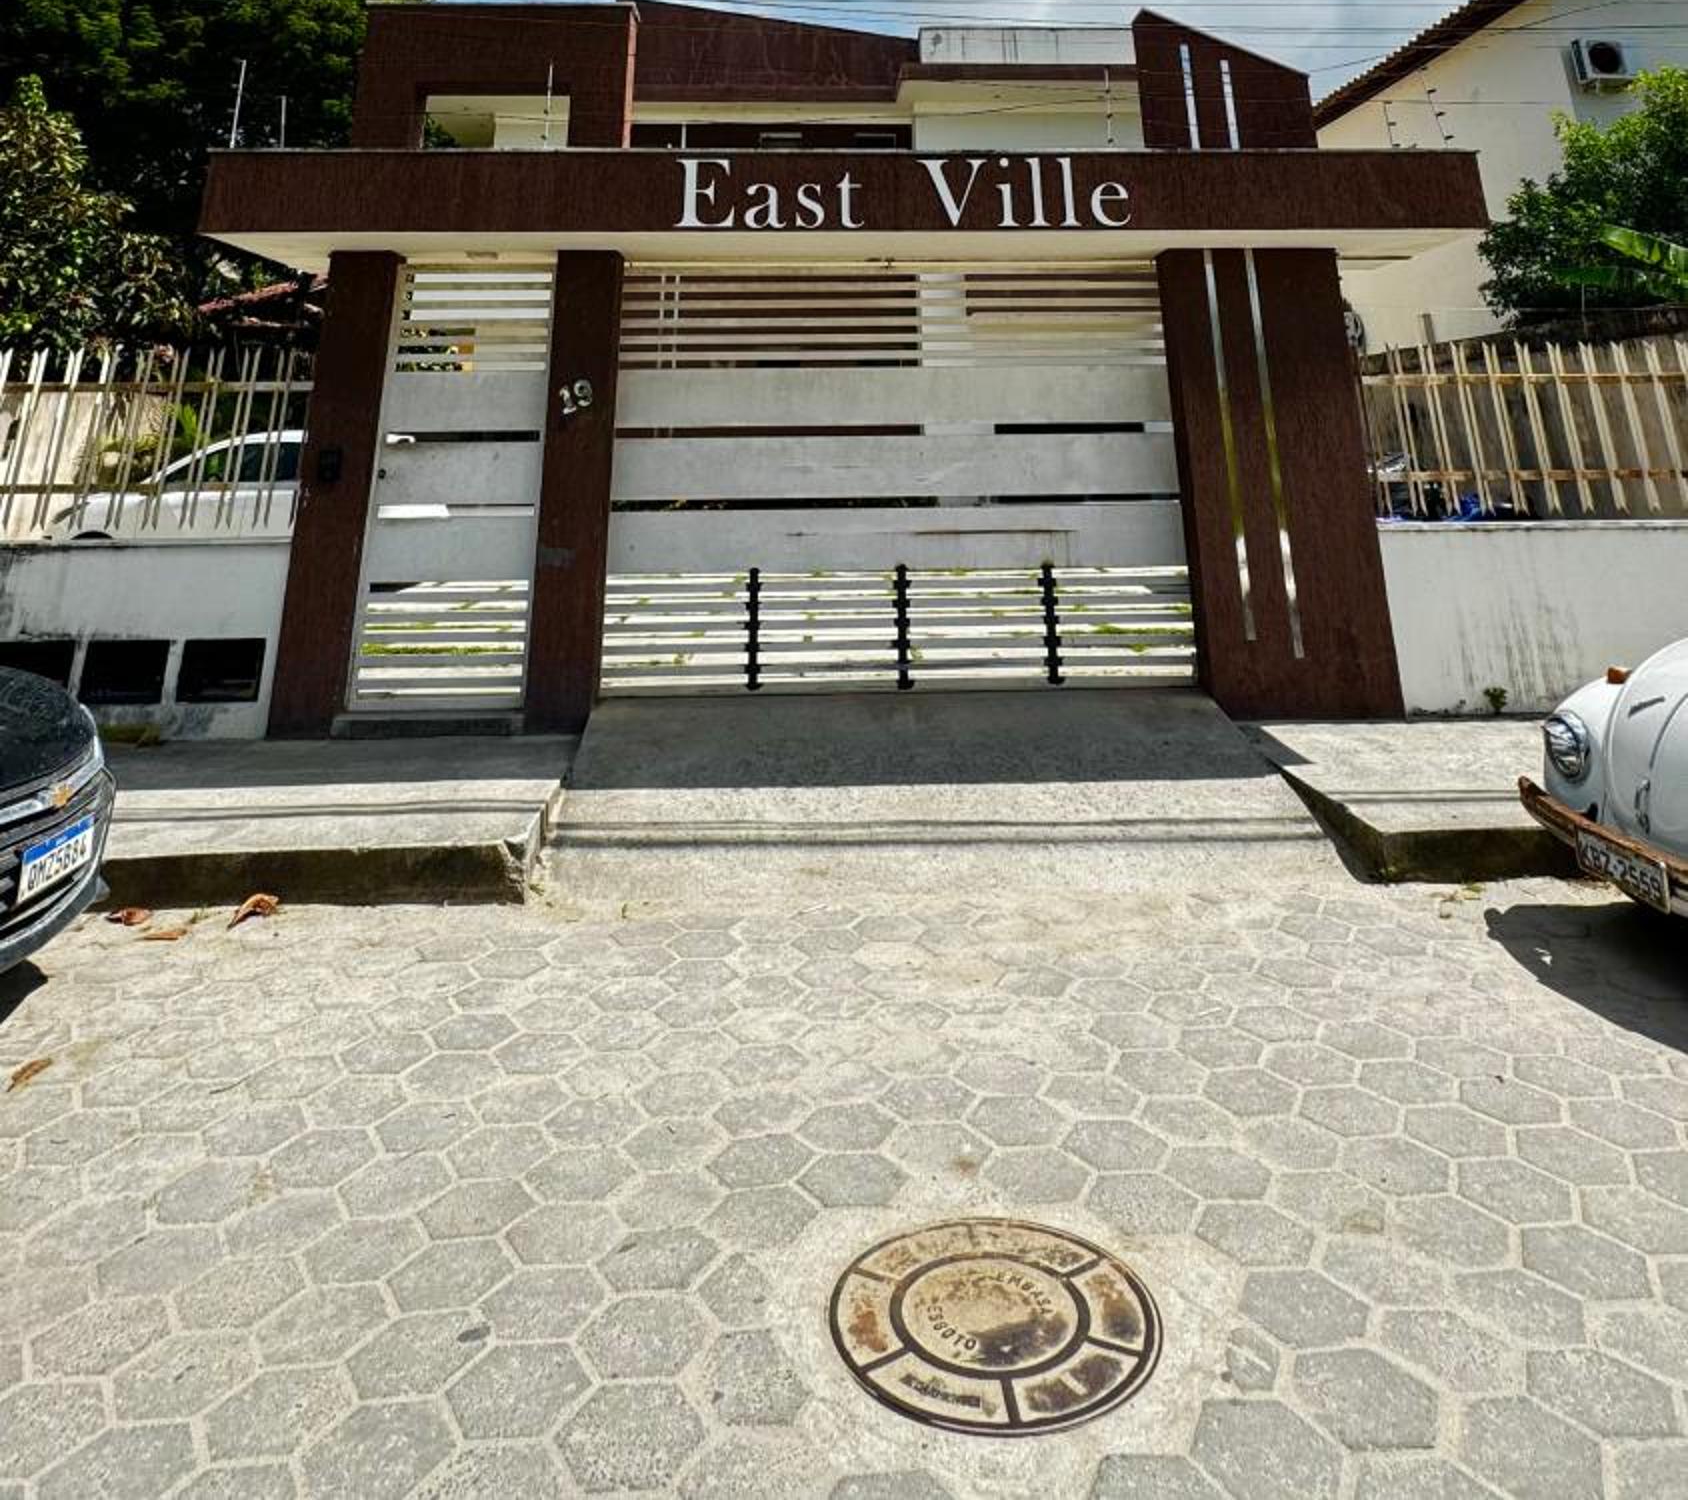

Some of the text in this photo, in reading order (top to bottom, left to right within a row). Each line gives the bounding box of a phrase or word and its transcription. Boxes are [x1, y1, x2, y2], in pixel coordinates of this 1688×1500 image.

[674, 157, 1132, 229] East Ville
[559, 378, 593, 415] 19
[996, 1271, 1053, 1316] EMBASA
[926, 1305, 977, 1351] ESGOTO
